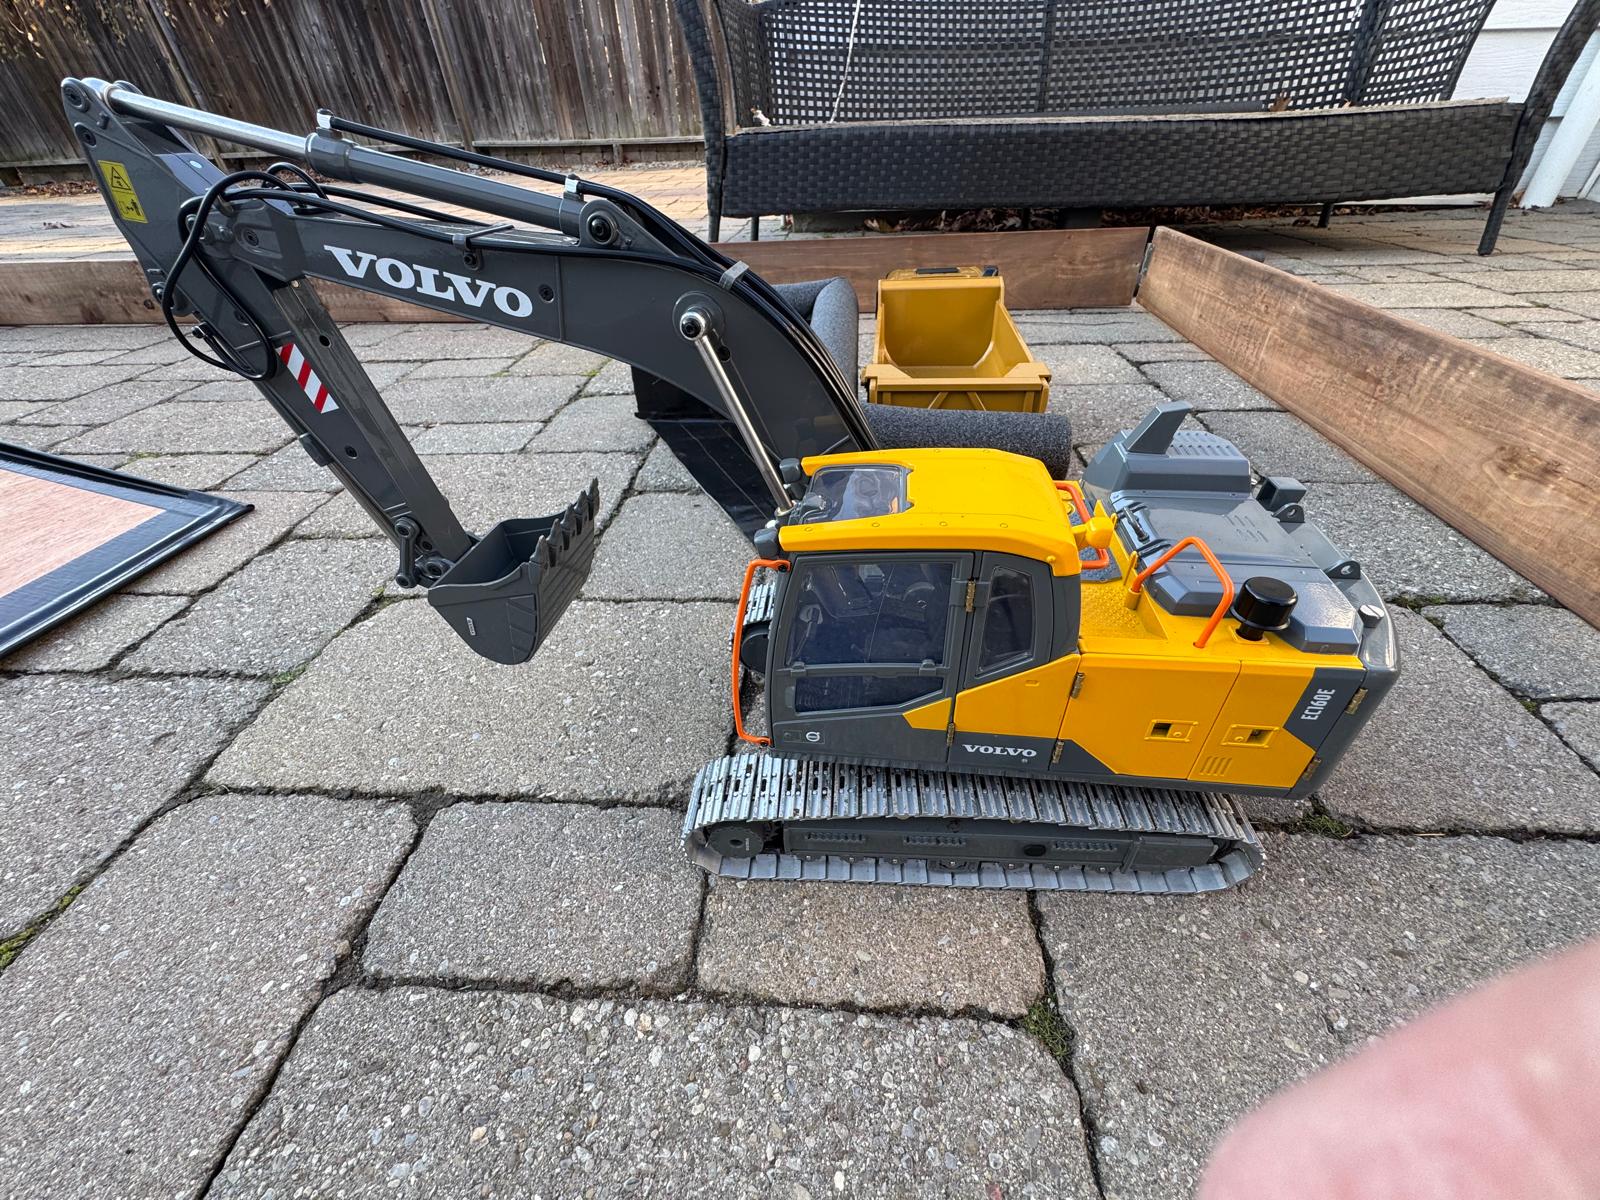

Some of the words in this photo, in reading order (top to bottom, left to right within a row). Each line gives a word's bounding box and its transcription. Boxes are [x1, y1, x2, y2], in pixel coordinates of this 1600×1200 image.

[323, 244, 534, 318] VOLVO
[1300, 688, 1336, 721] EC160E
[961, 743, 1038, 758] VOLVO
